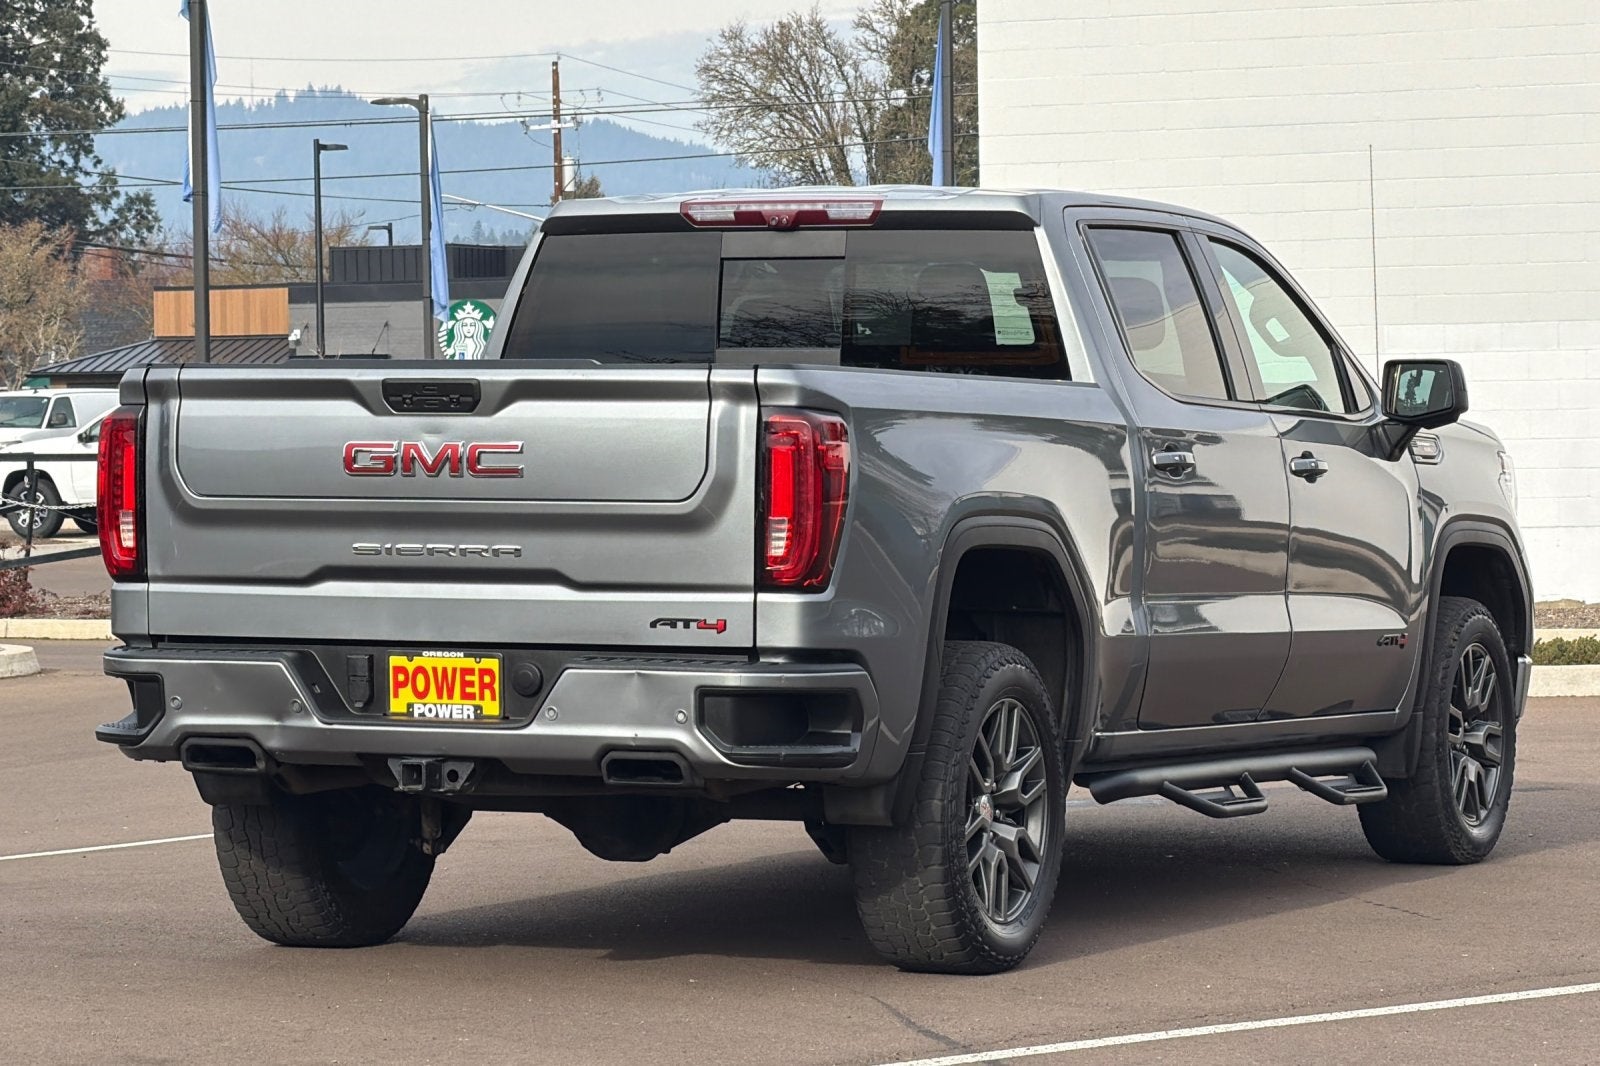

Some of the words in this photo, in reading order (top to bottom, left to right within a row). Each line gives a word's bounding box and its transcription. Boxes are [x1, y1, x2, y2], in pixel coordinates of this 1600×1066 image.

[343, 440, 524, 478] GMC
[352, 543, 522, 557] SIERRA
[650, 618, 727, 634] AT4
[392, 665, 497, 702] POWER
[413, 703, 475, 719] POWER
